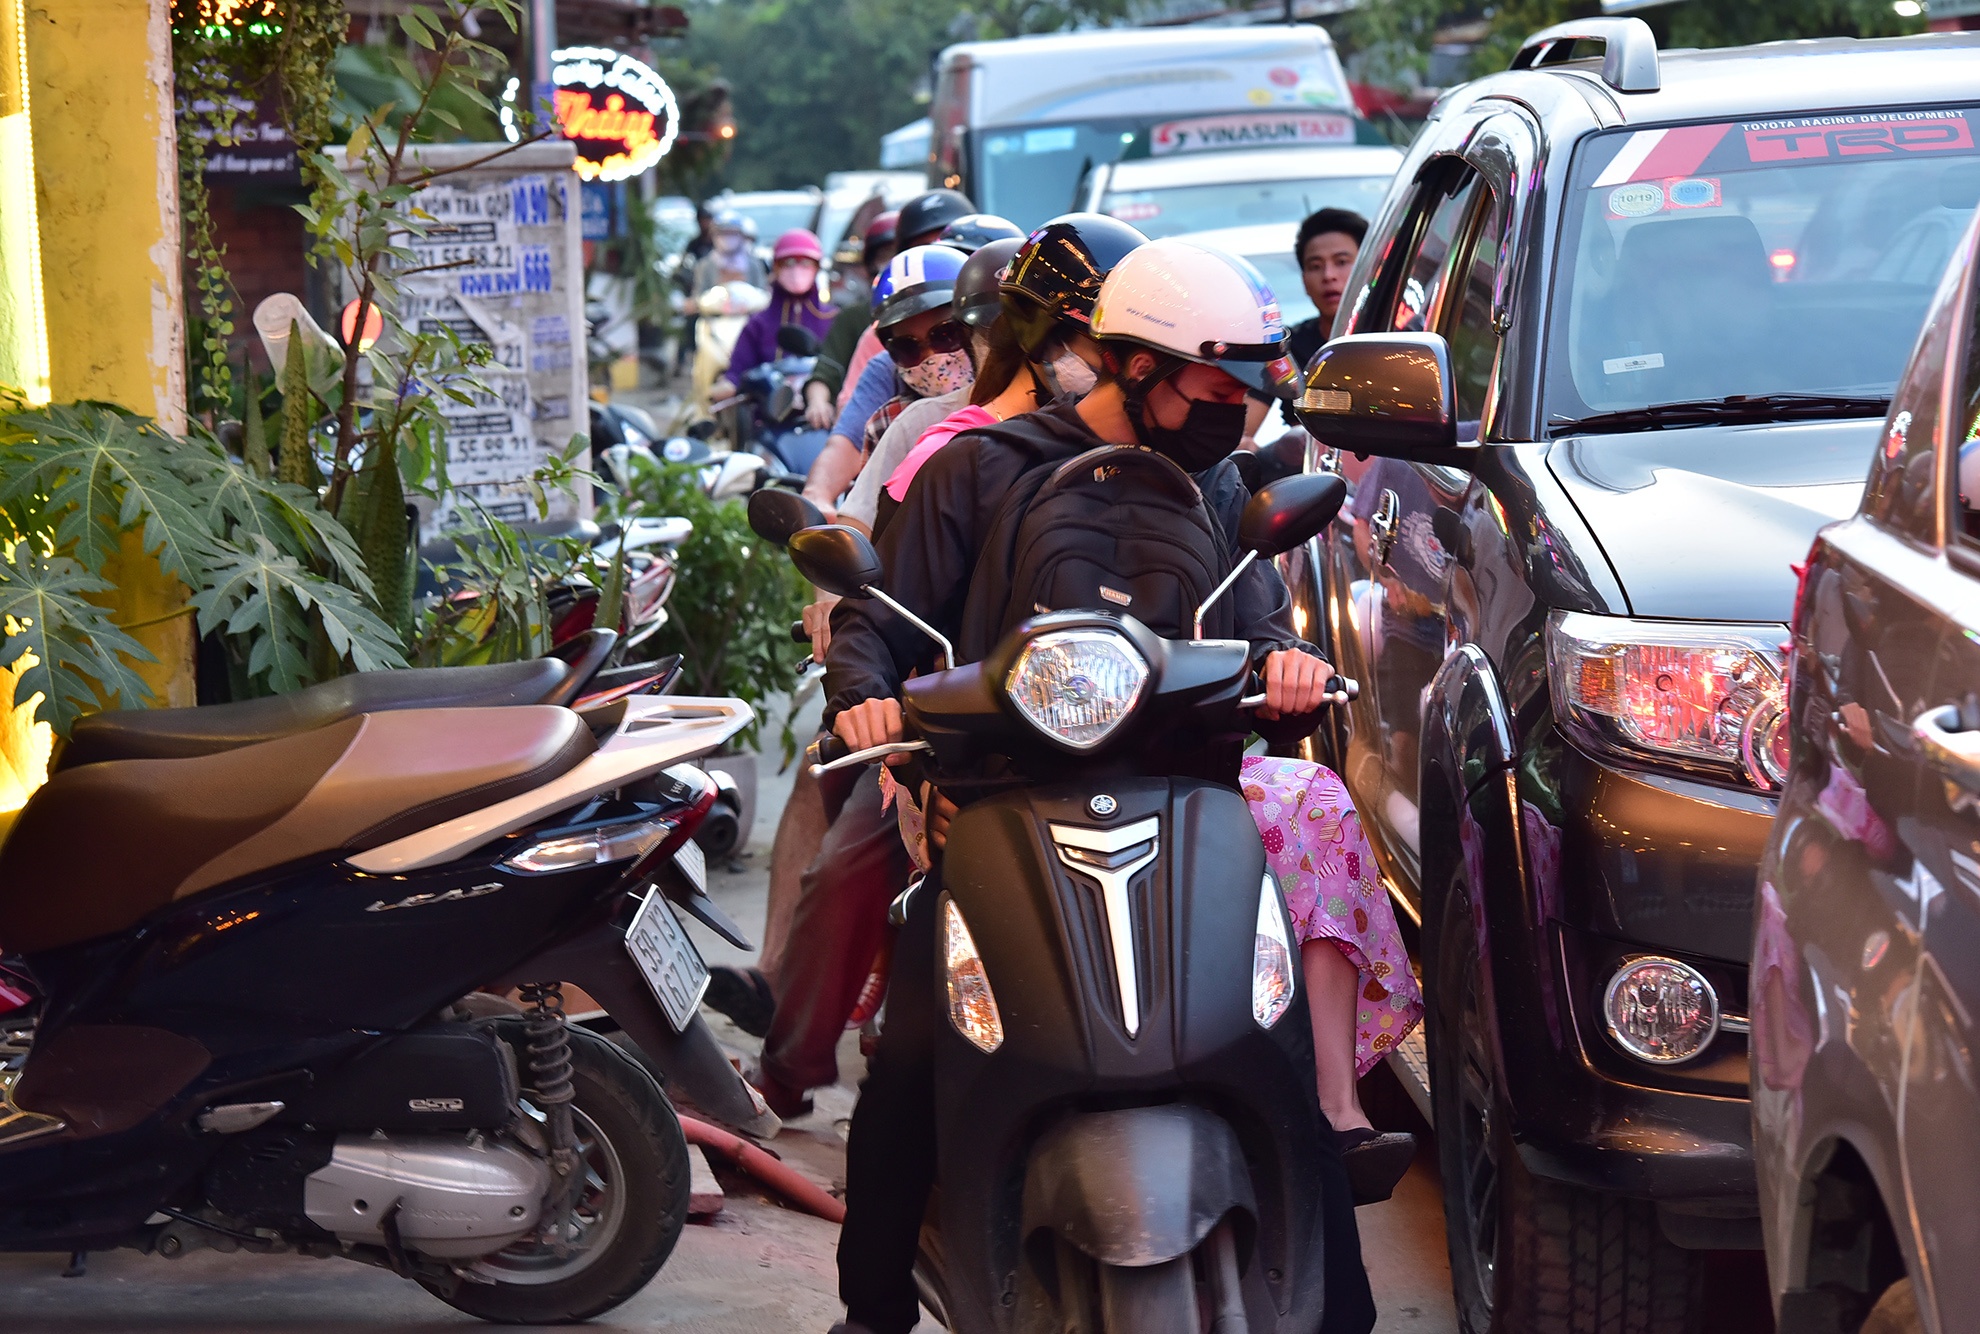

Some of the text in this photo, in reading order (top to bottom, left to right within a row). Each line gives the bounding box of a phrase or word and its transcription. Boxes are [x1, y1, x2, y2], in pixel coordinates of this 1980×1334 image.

[1200, 119, 1345, 146] VINASUN TAXI
[1741, 109, 1965, 132] TOYOTA RACING DEVELOPMENT
[1756, 124, 1960, 157] TRD
[1620, 193, 1653, 204] 10/19
[1680, 186, 1708, 195] 10/19
[365, 882, 504, 912] LEAD
